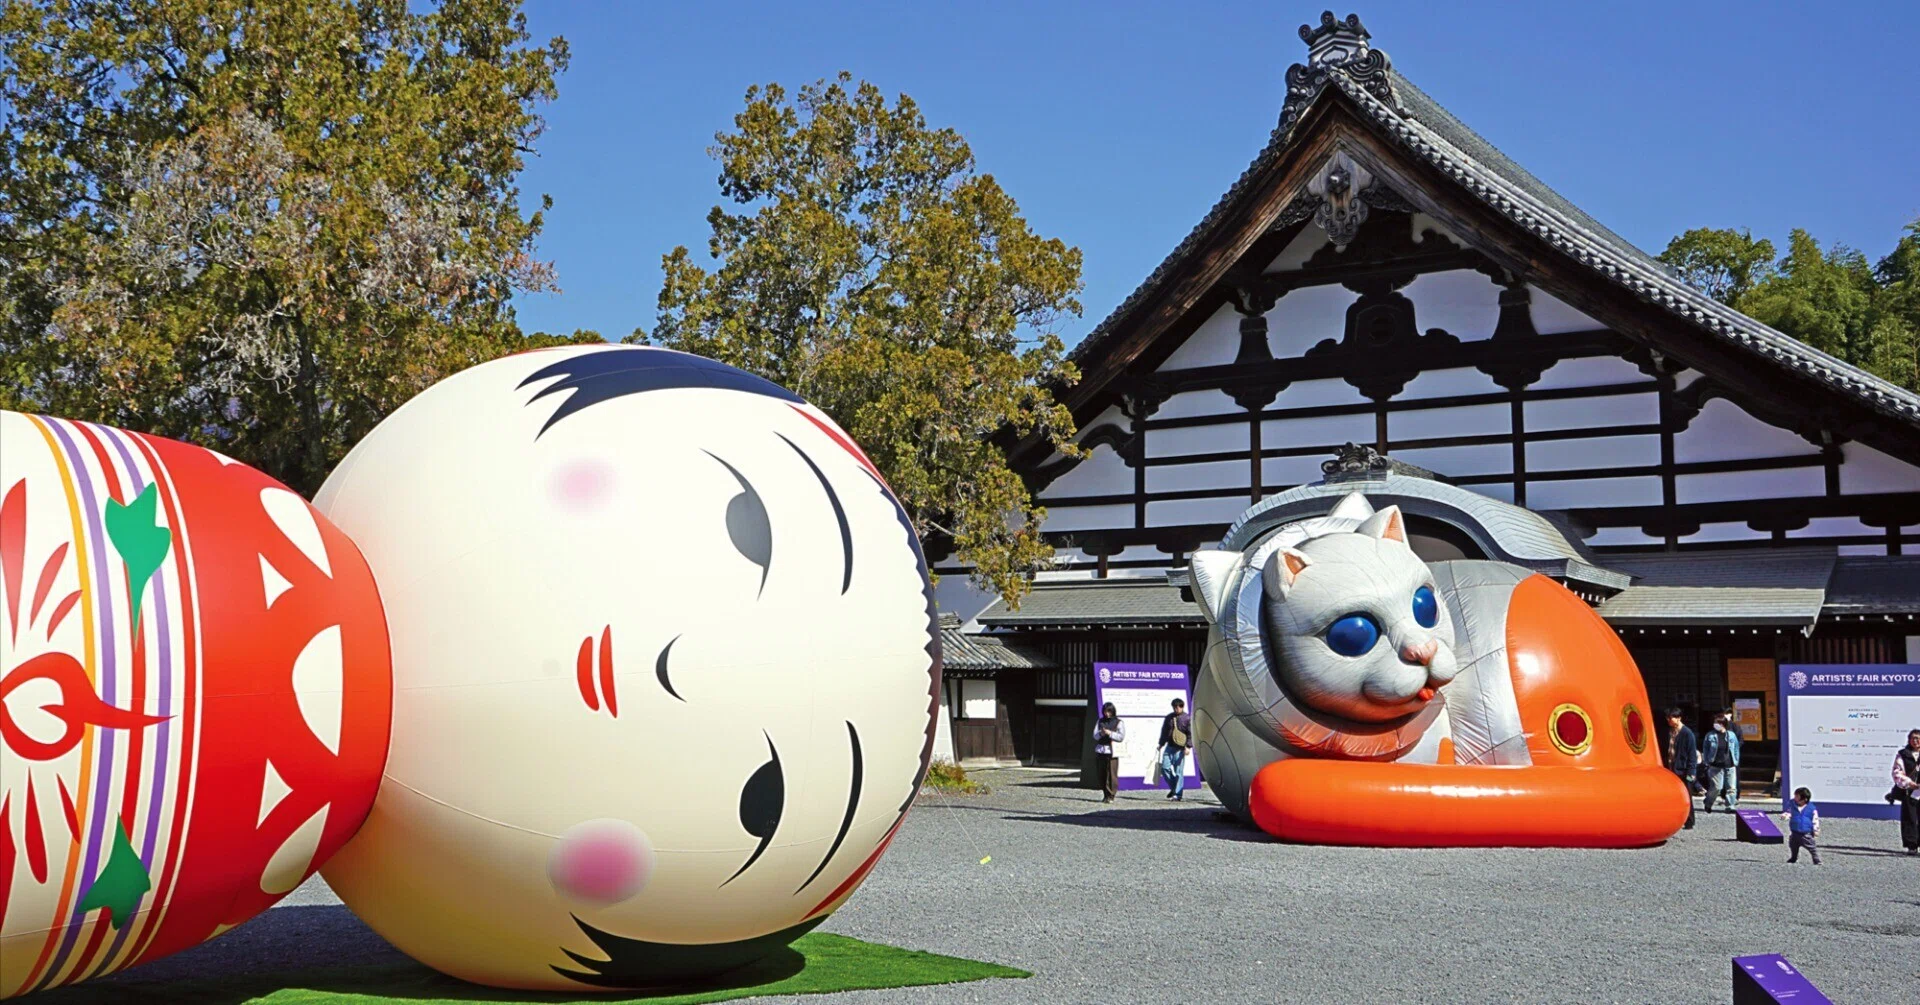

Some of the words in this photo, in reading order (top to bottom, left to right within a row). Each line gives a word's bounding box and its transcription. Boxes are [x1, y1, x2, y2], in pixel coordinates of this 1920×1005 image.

[1152, 671, 1170, 679] KYOTO
[1857, 674, 1879, 682] FAIR
[1881, 674, 1915, 682] KYOTO
